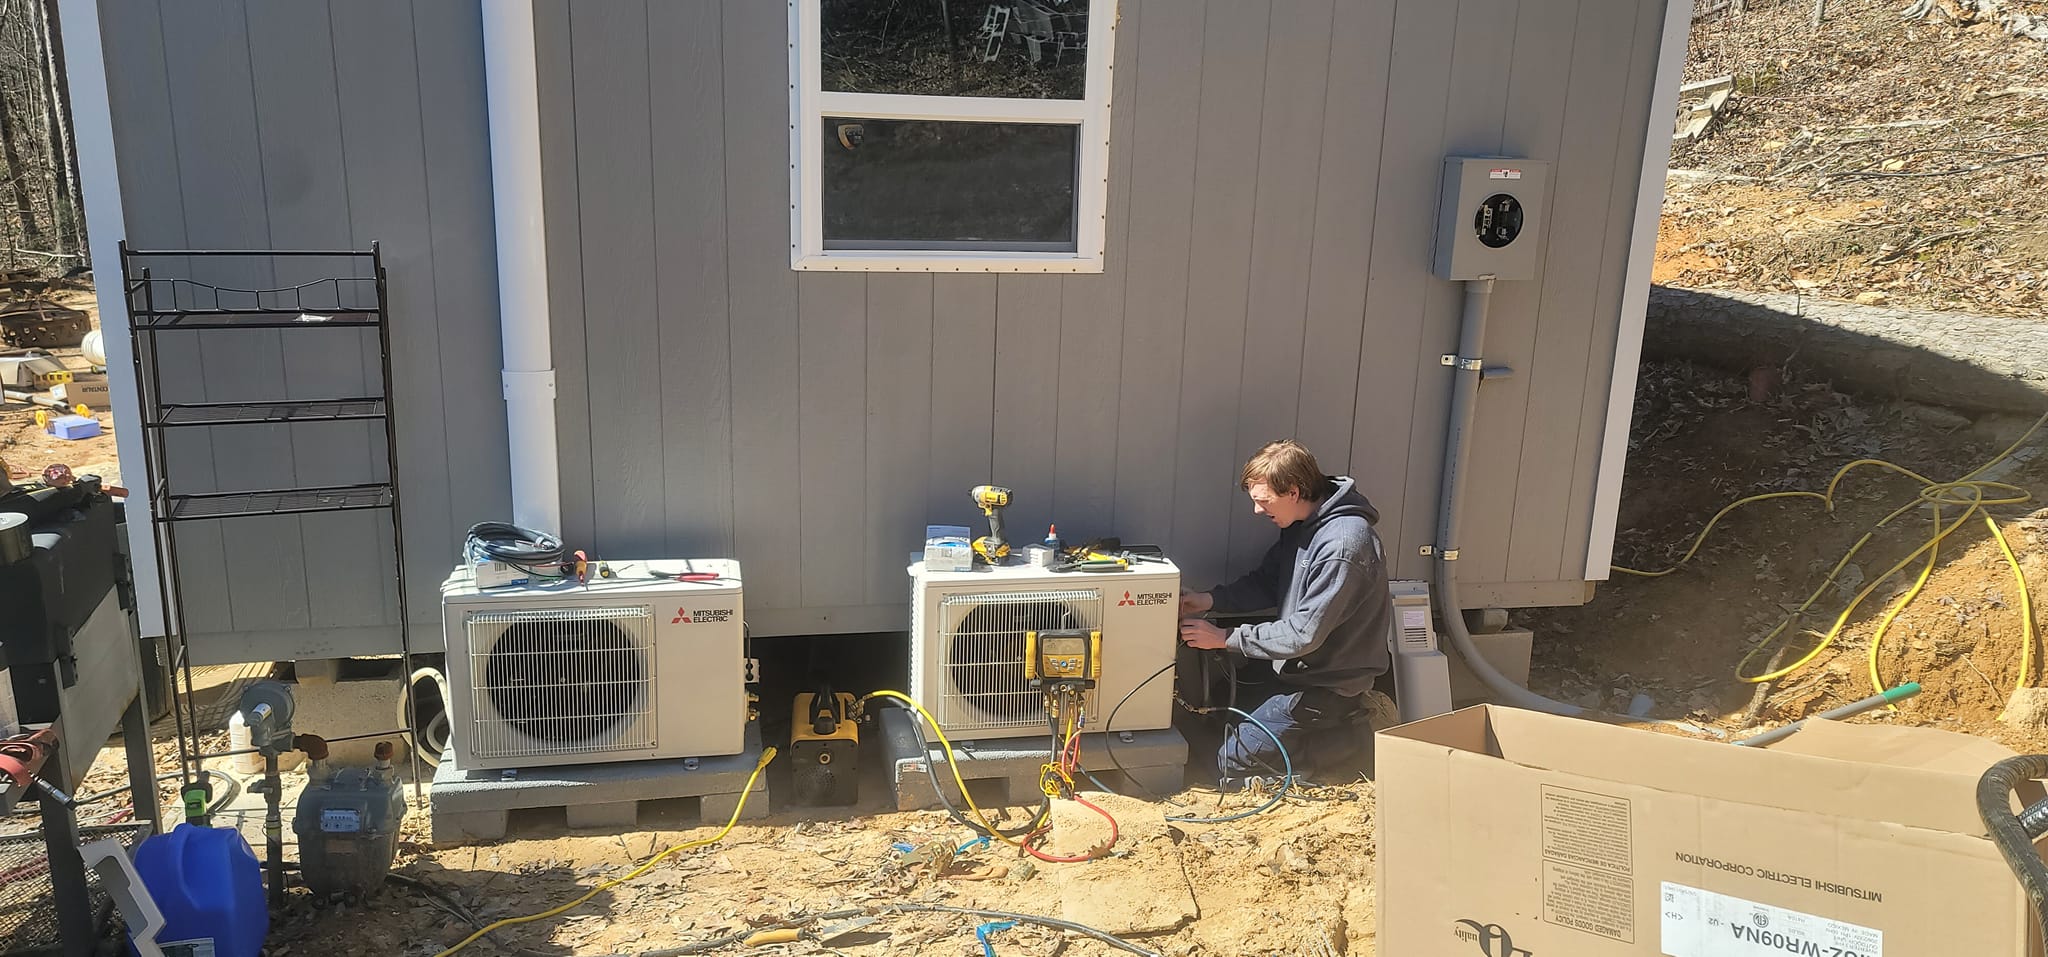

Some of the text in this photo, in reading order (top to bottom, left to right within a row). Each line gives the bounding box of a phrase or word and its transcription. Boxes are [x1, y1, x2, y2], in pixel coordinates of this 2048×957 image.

[1675, 851, 1882, 903] MITSUBISHI ELECTRIC CORPORATION
[1555, 914, 1622, 938] DAMAGED GOODS POLICY
[1730, 922, 1870, 957] Z-WR09NA
